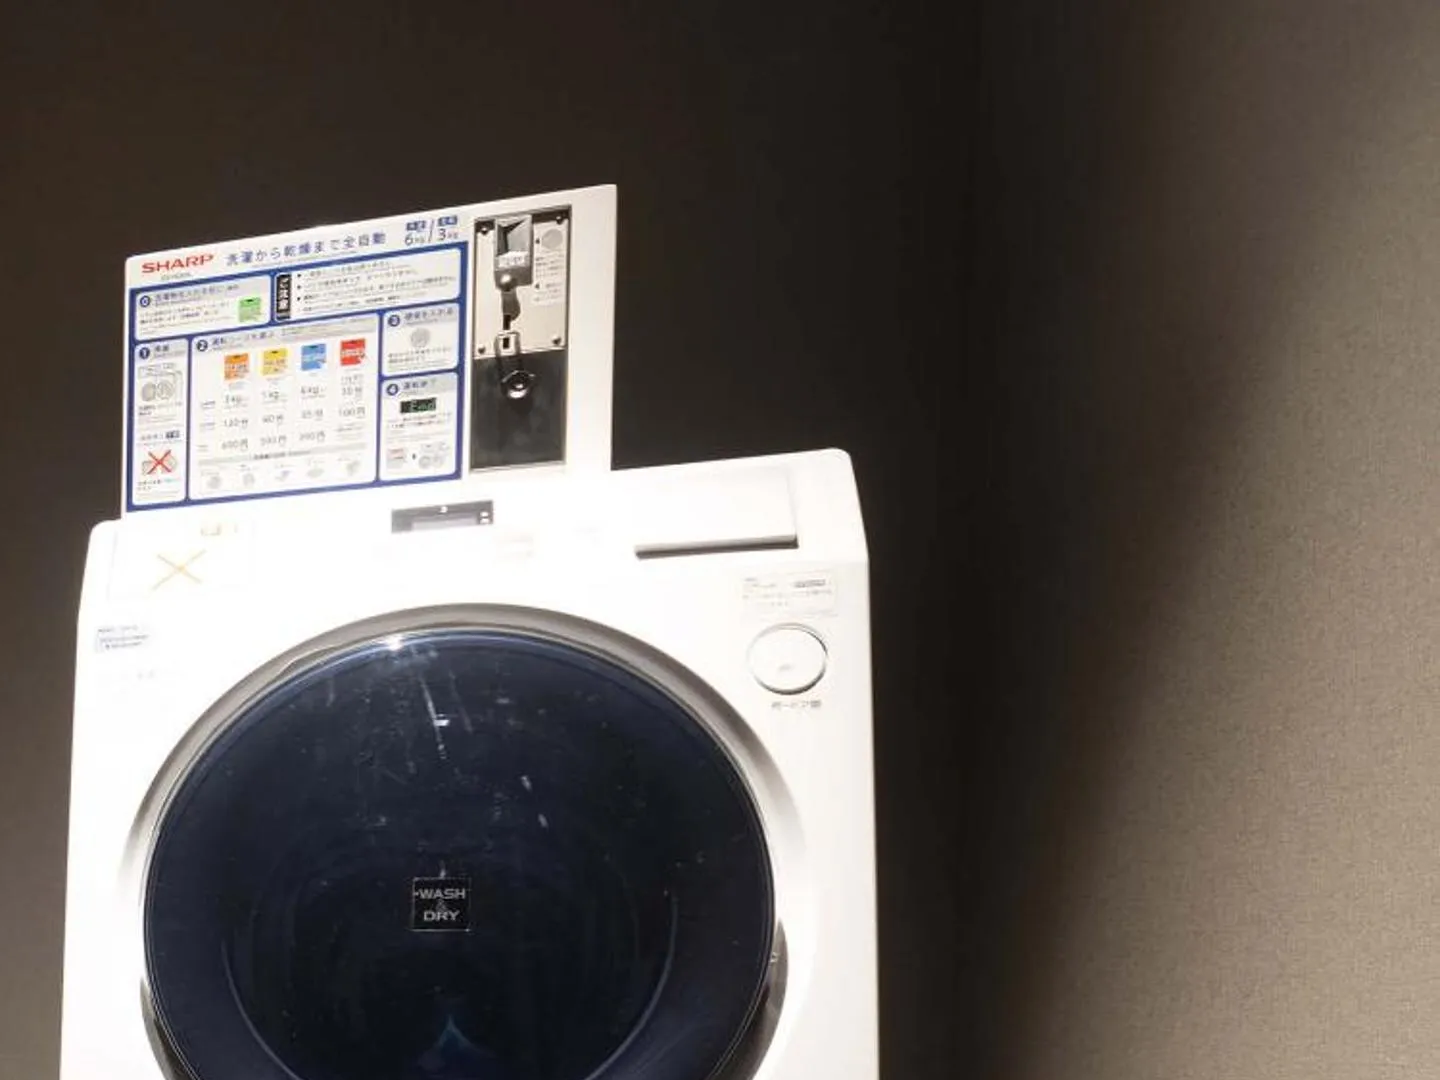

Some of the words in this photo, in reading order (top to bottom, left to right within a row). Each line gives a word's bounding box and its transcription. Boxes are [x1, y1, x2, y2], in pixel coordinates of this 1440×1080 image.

[141, 253, 215, 274] SHARP
[418, 888, 466, 899] WASH
[423, 910, 461, 921] DRY
